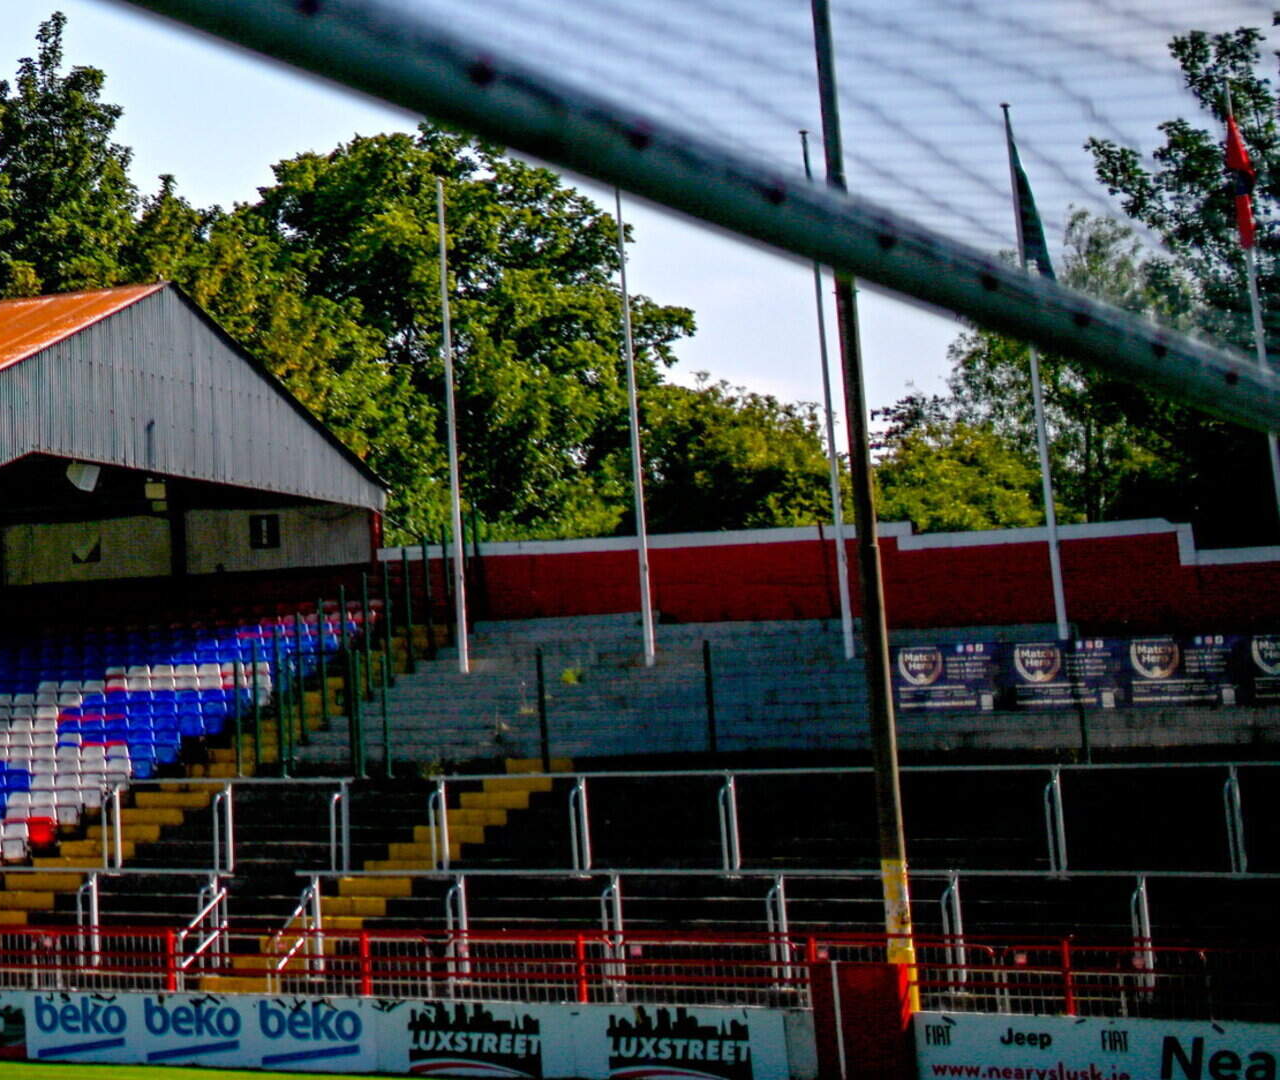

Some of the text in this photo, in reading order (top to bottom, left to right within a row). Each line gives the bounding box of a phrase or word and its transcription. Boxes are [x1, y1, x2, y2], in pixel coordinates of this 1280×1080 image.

[34, 996, 127, 1035] beko
[144, 998, 242, 1038] beko
[259, 1000, 363, 1042] beko
[409, 1029, 541, 1057] LUXSTREET
[609, 1036, 751, 1062] LUXSTREET
[925, 1024, 1128, 1053] FIAT Jeep FIAT
